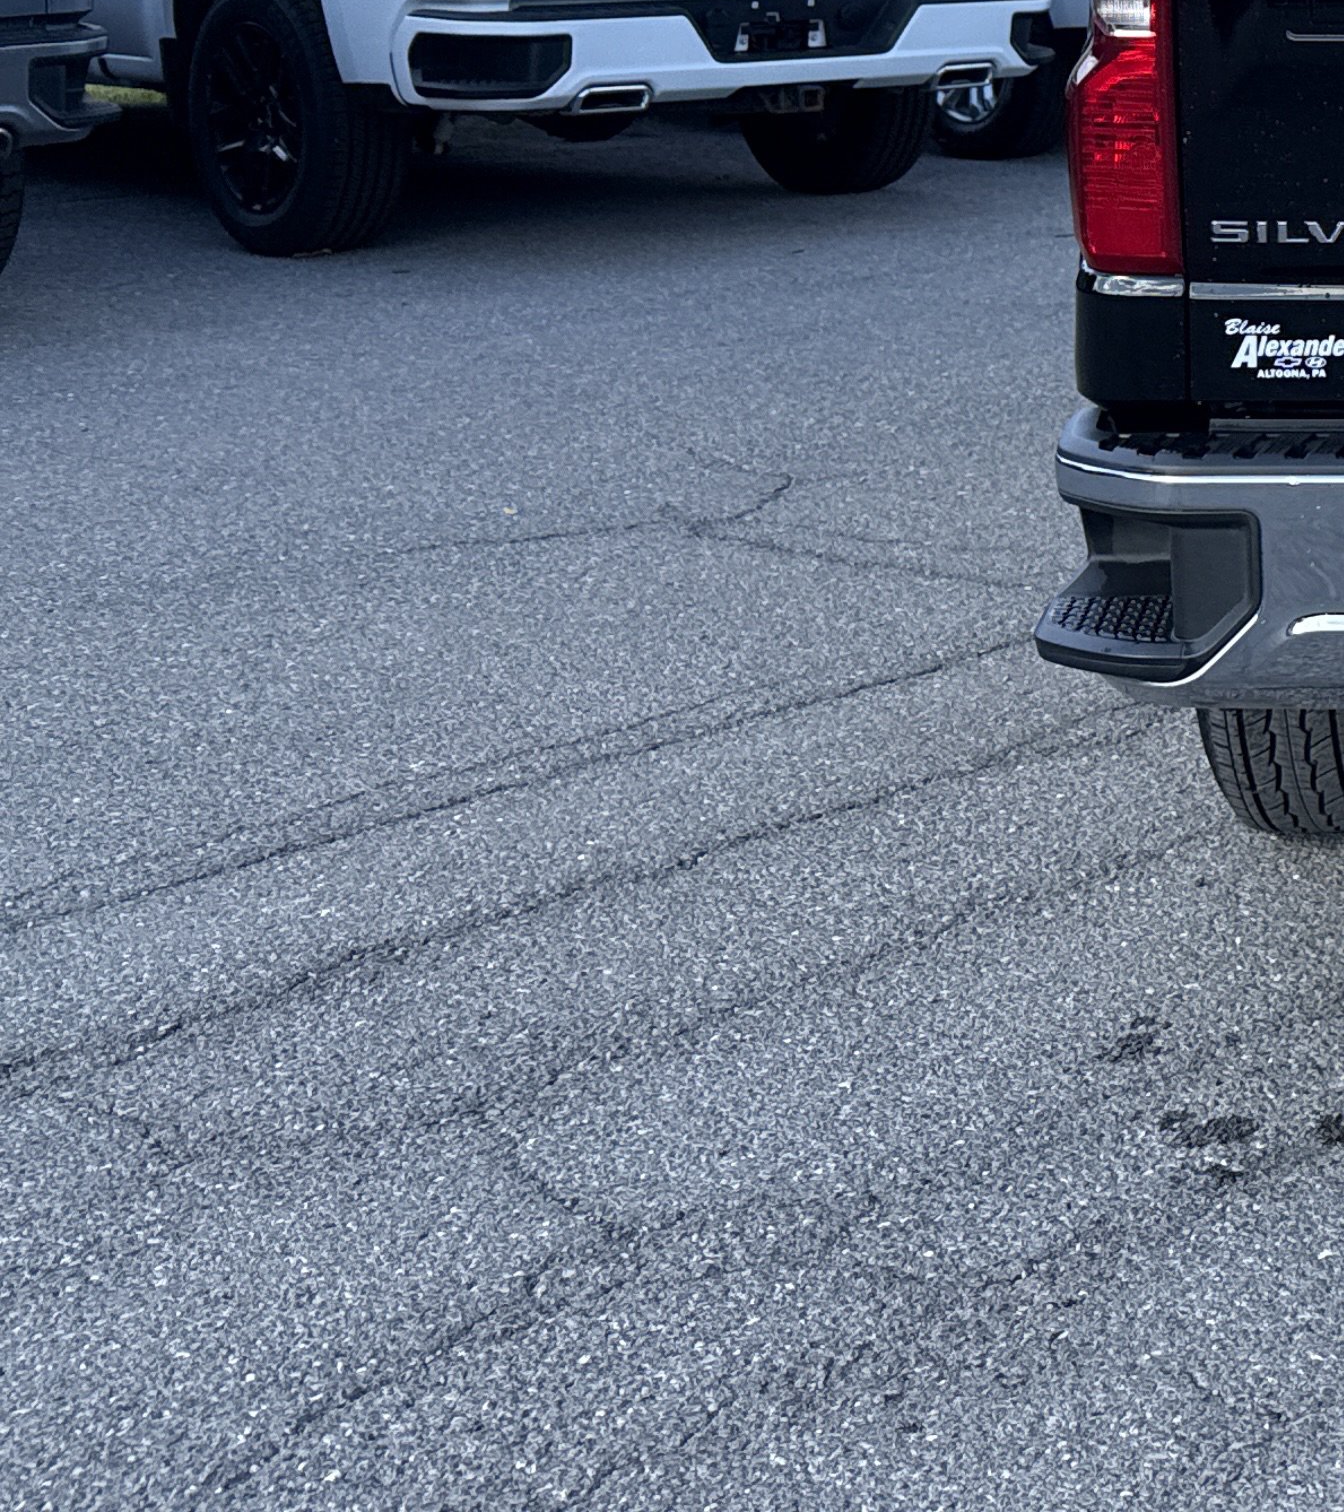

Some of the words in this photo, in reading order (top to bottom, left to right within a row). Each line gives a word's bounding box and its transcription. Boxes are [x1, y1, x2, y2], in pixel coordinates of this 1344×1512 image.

[1224, 317, 1281, 336] Blaise
[1256, 368, 1311, 380] ALTOONA,
[1311, 368, 1327, 378] PA
